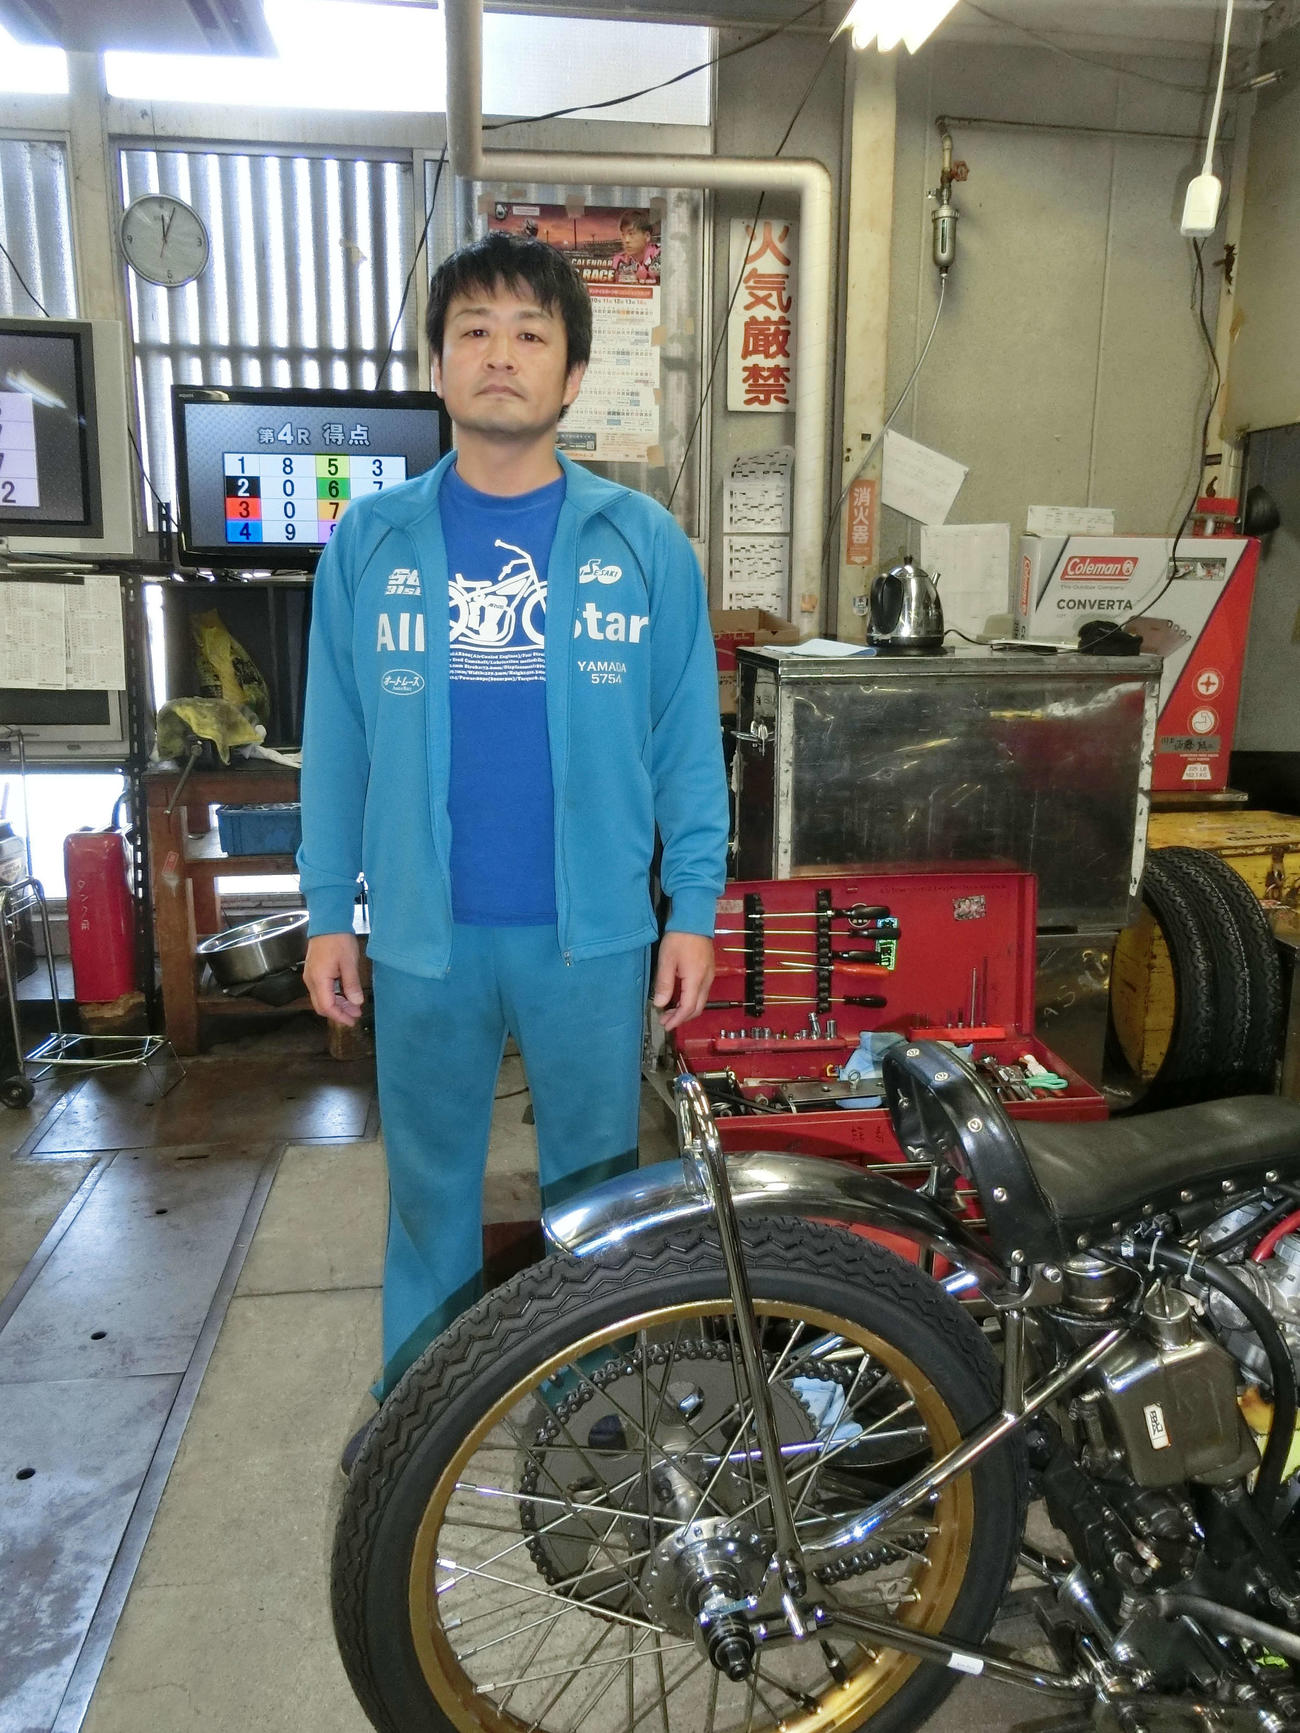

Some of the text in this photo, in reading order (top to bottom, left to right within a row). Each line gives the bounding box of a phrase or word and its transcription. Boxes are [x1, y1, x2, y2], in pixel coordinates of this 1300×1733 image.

[582, 268, 616, 282] RACE
[741, 221, 792, 405] 火気厳禁
[258, 422, 370, 446] 第4R 得点
[238, 456, 383, 476] 1 8 5 3
[2, 481, 16, 503] 2
[238, 480, 250, 496] 2
[282, 480, 294, 498] 0
[328, 480, 340, 497] 6
[238, 501, 340, 519] 3 0 7
[852, 487, 871, 544] 消火器
[239, 523, 296, 541] 4 9
[1068, 558, 1120, 576] Coleman
[1057, 599, 1132, 610] CONVERTA
[376, 612, 424, 652] All
[578, 661, 626, 672] YAMADA
[592, 674, 622, 684] 5754
